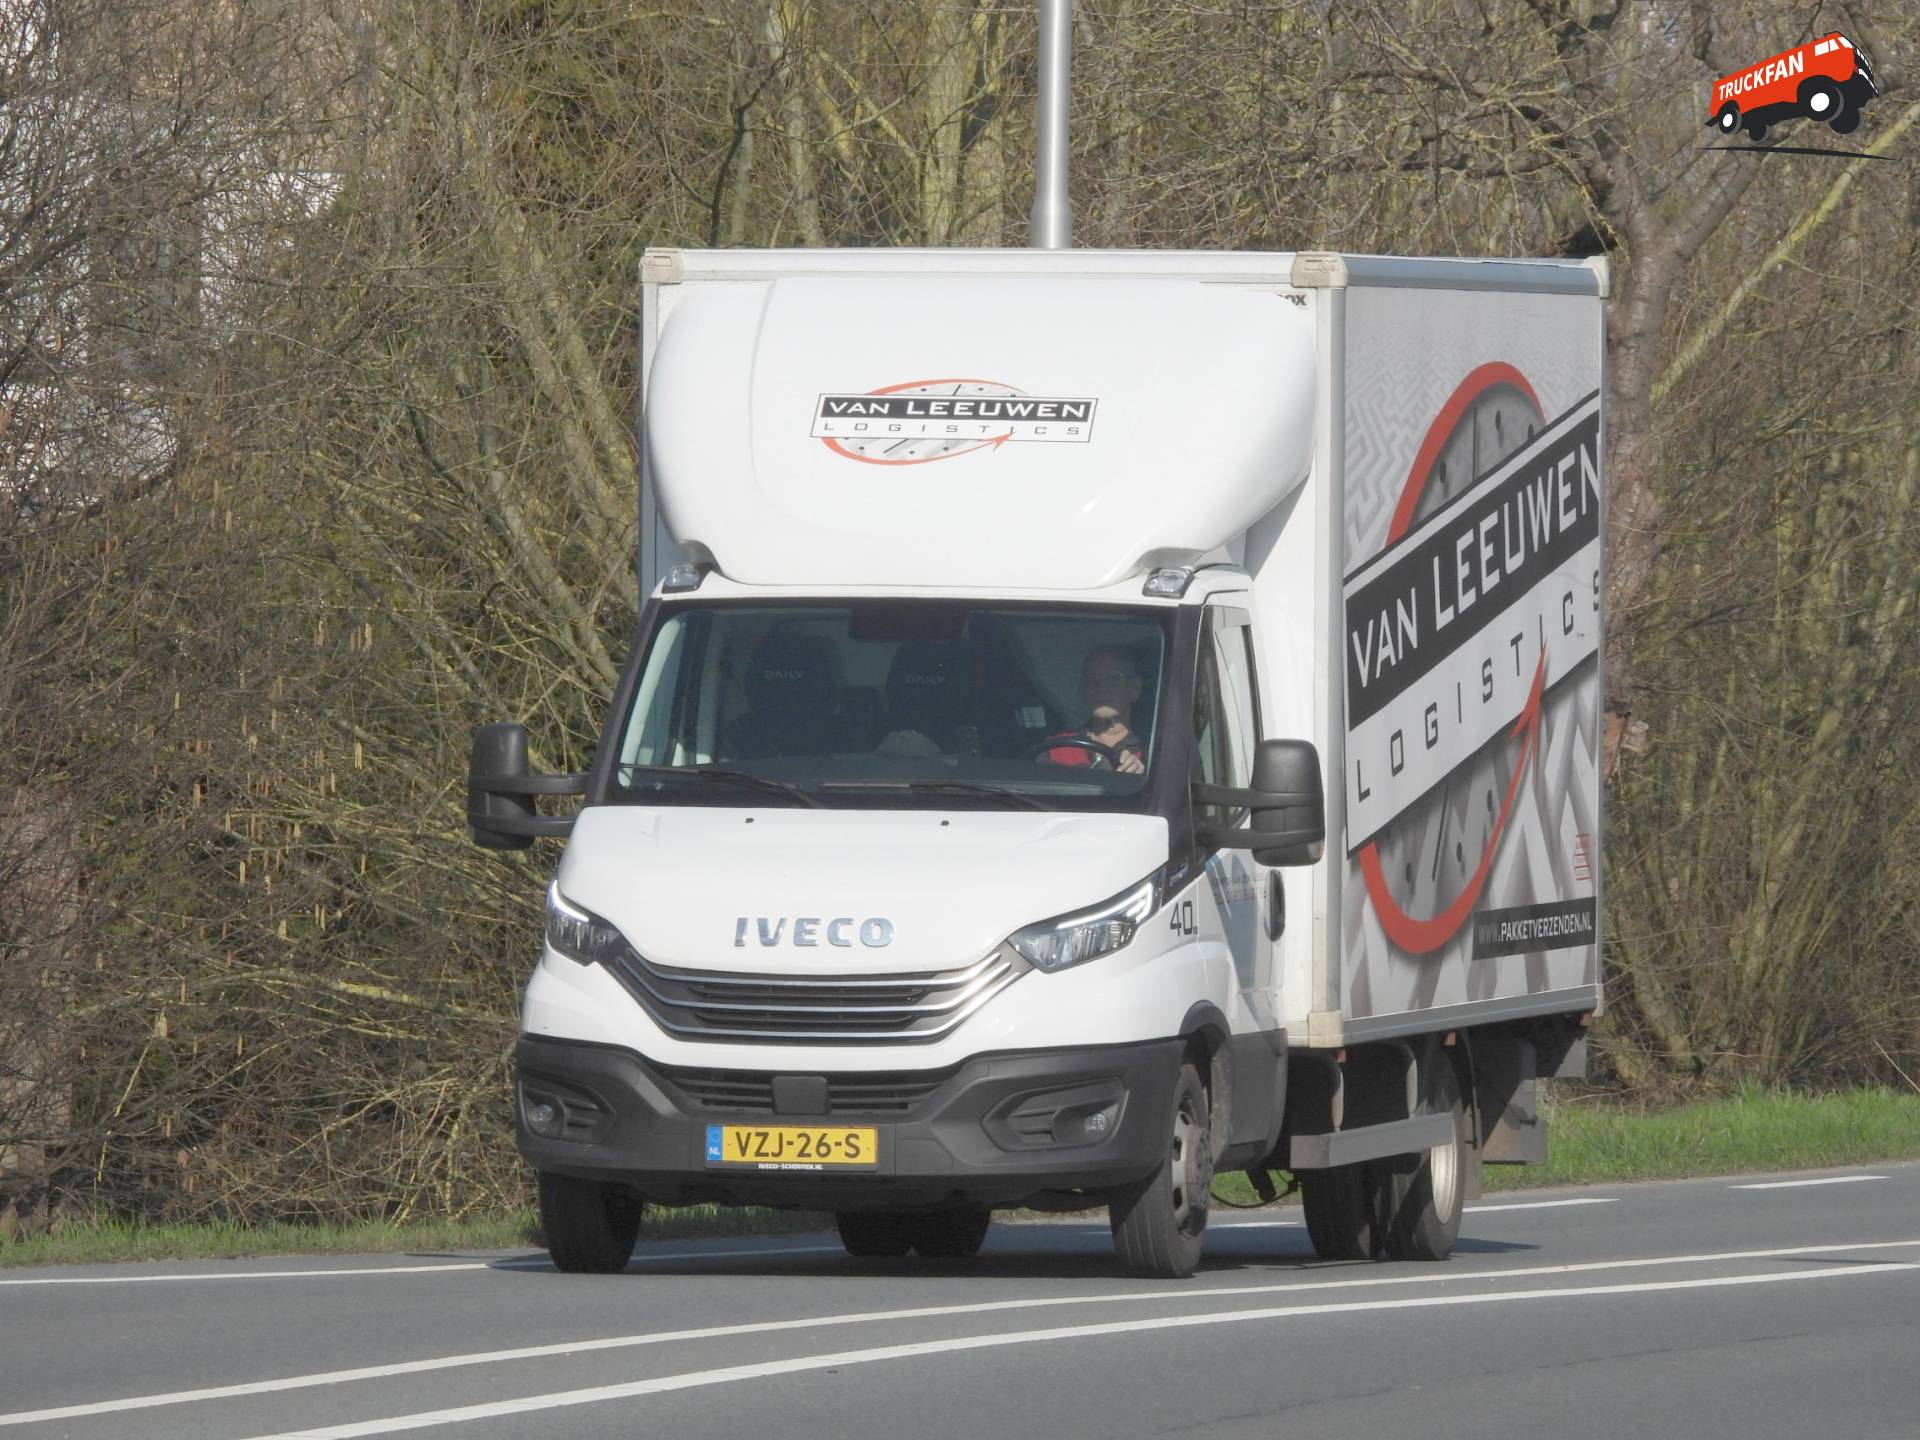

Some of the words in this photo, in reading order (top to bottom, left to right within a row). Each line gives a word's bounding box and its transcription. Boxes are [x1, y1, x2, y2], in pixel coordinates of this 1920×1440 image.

[829, 401, 889, 414] VAN
[906, 401, 1085, 418] LEEUWEN
[824, 422, 1080, 436] LOGISTICS
[1352, 587, 1418, 688] VAN
[1433, 431, 1599, 632] LEEUWEN
[764, 670, 804, 680] DAILY
[734, 917, 894, 947] IVECO
[709, 1146, 720, 1155] NL
[735, 1132, 861, 1158] VZJ-26-S
